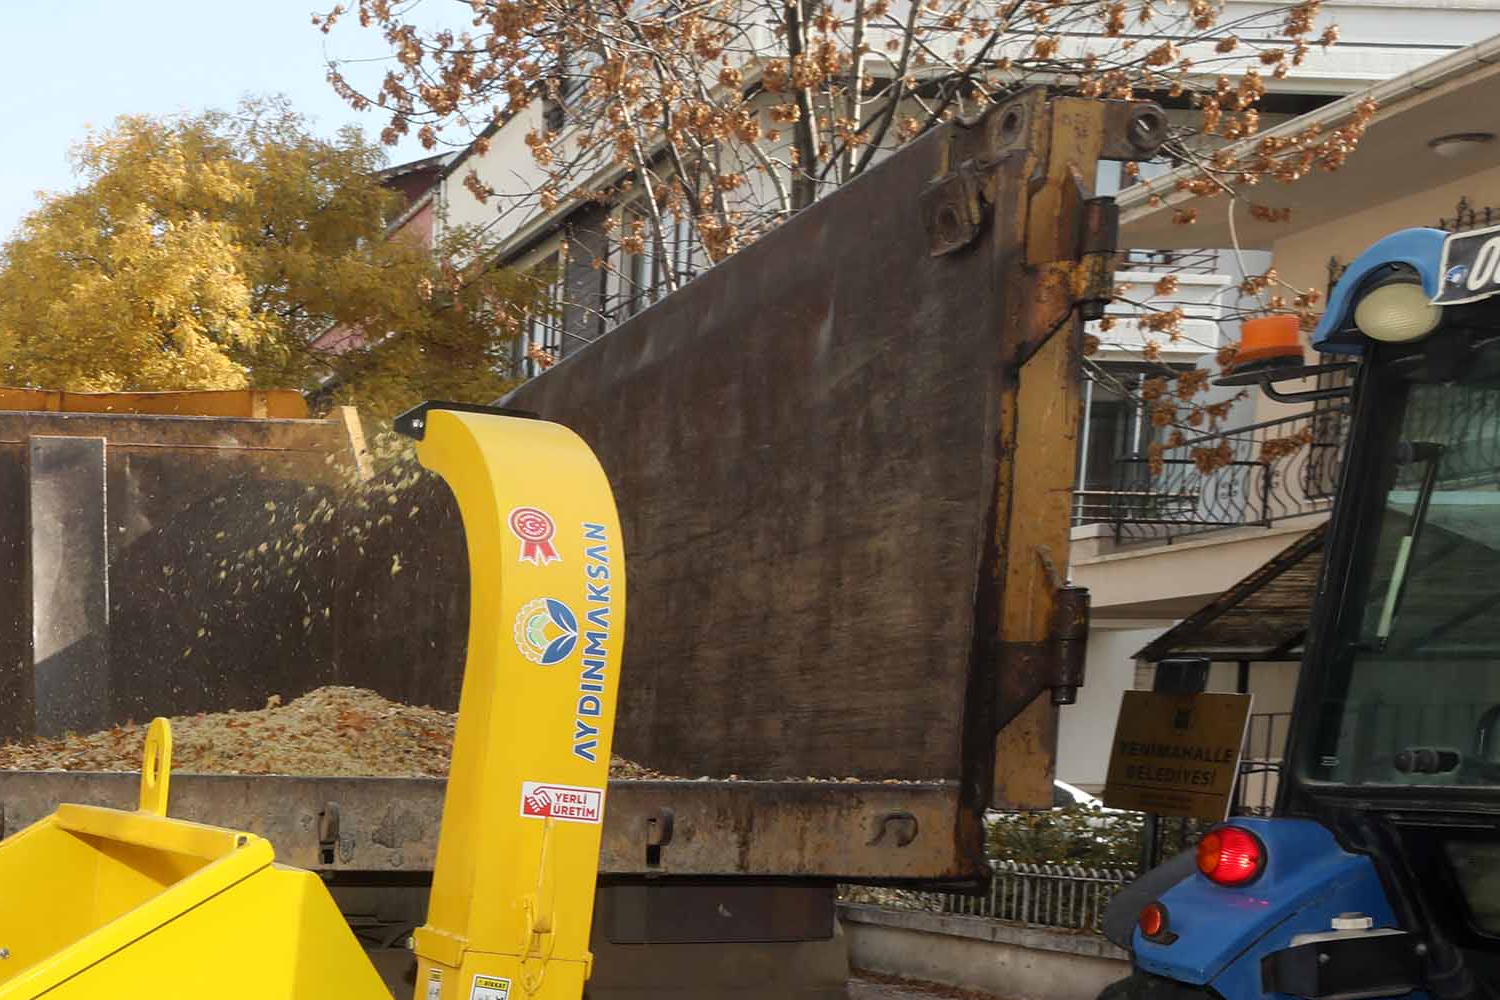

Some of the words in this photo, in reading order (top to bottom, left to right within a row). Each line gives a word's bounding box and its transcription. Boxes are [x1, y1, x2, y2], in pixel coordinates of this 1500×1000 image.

[573, 522, 610, 763] AYDINMAKSAN
[555, 792, 587, 804] YERLİ
[553, 804, 595, 817] ÜRETİM
